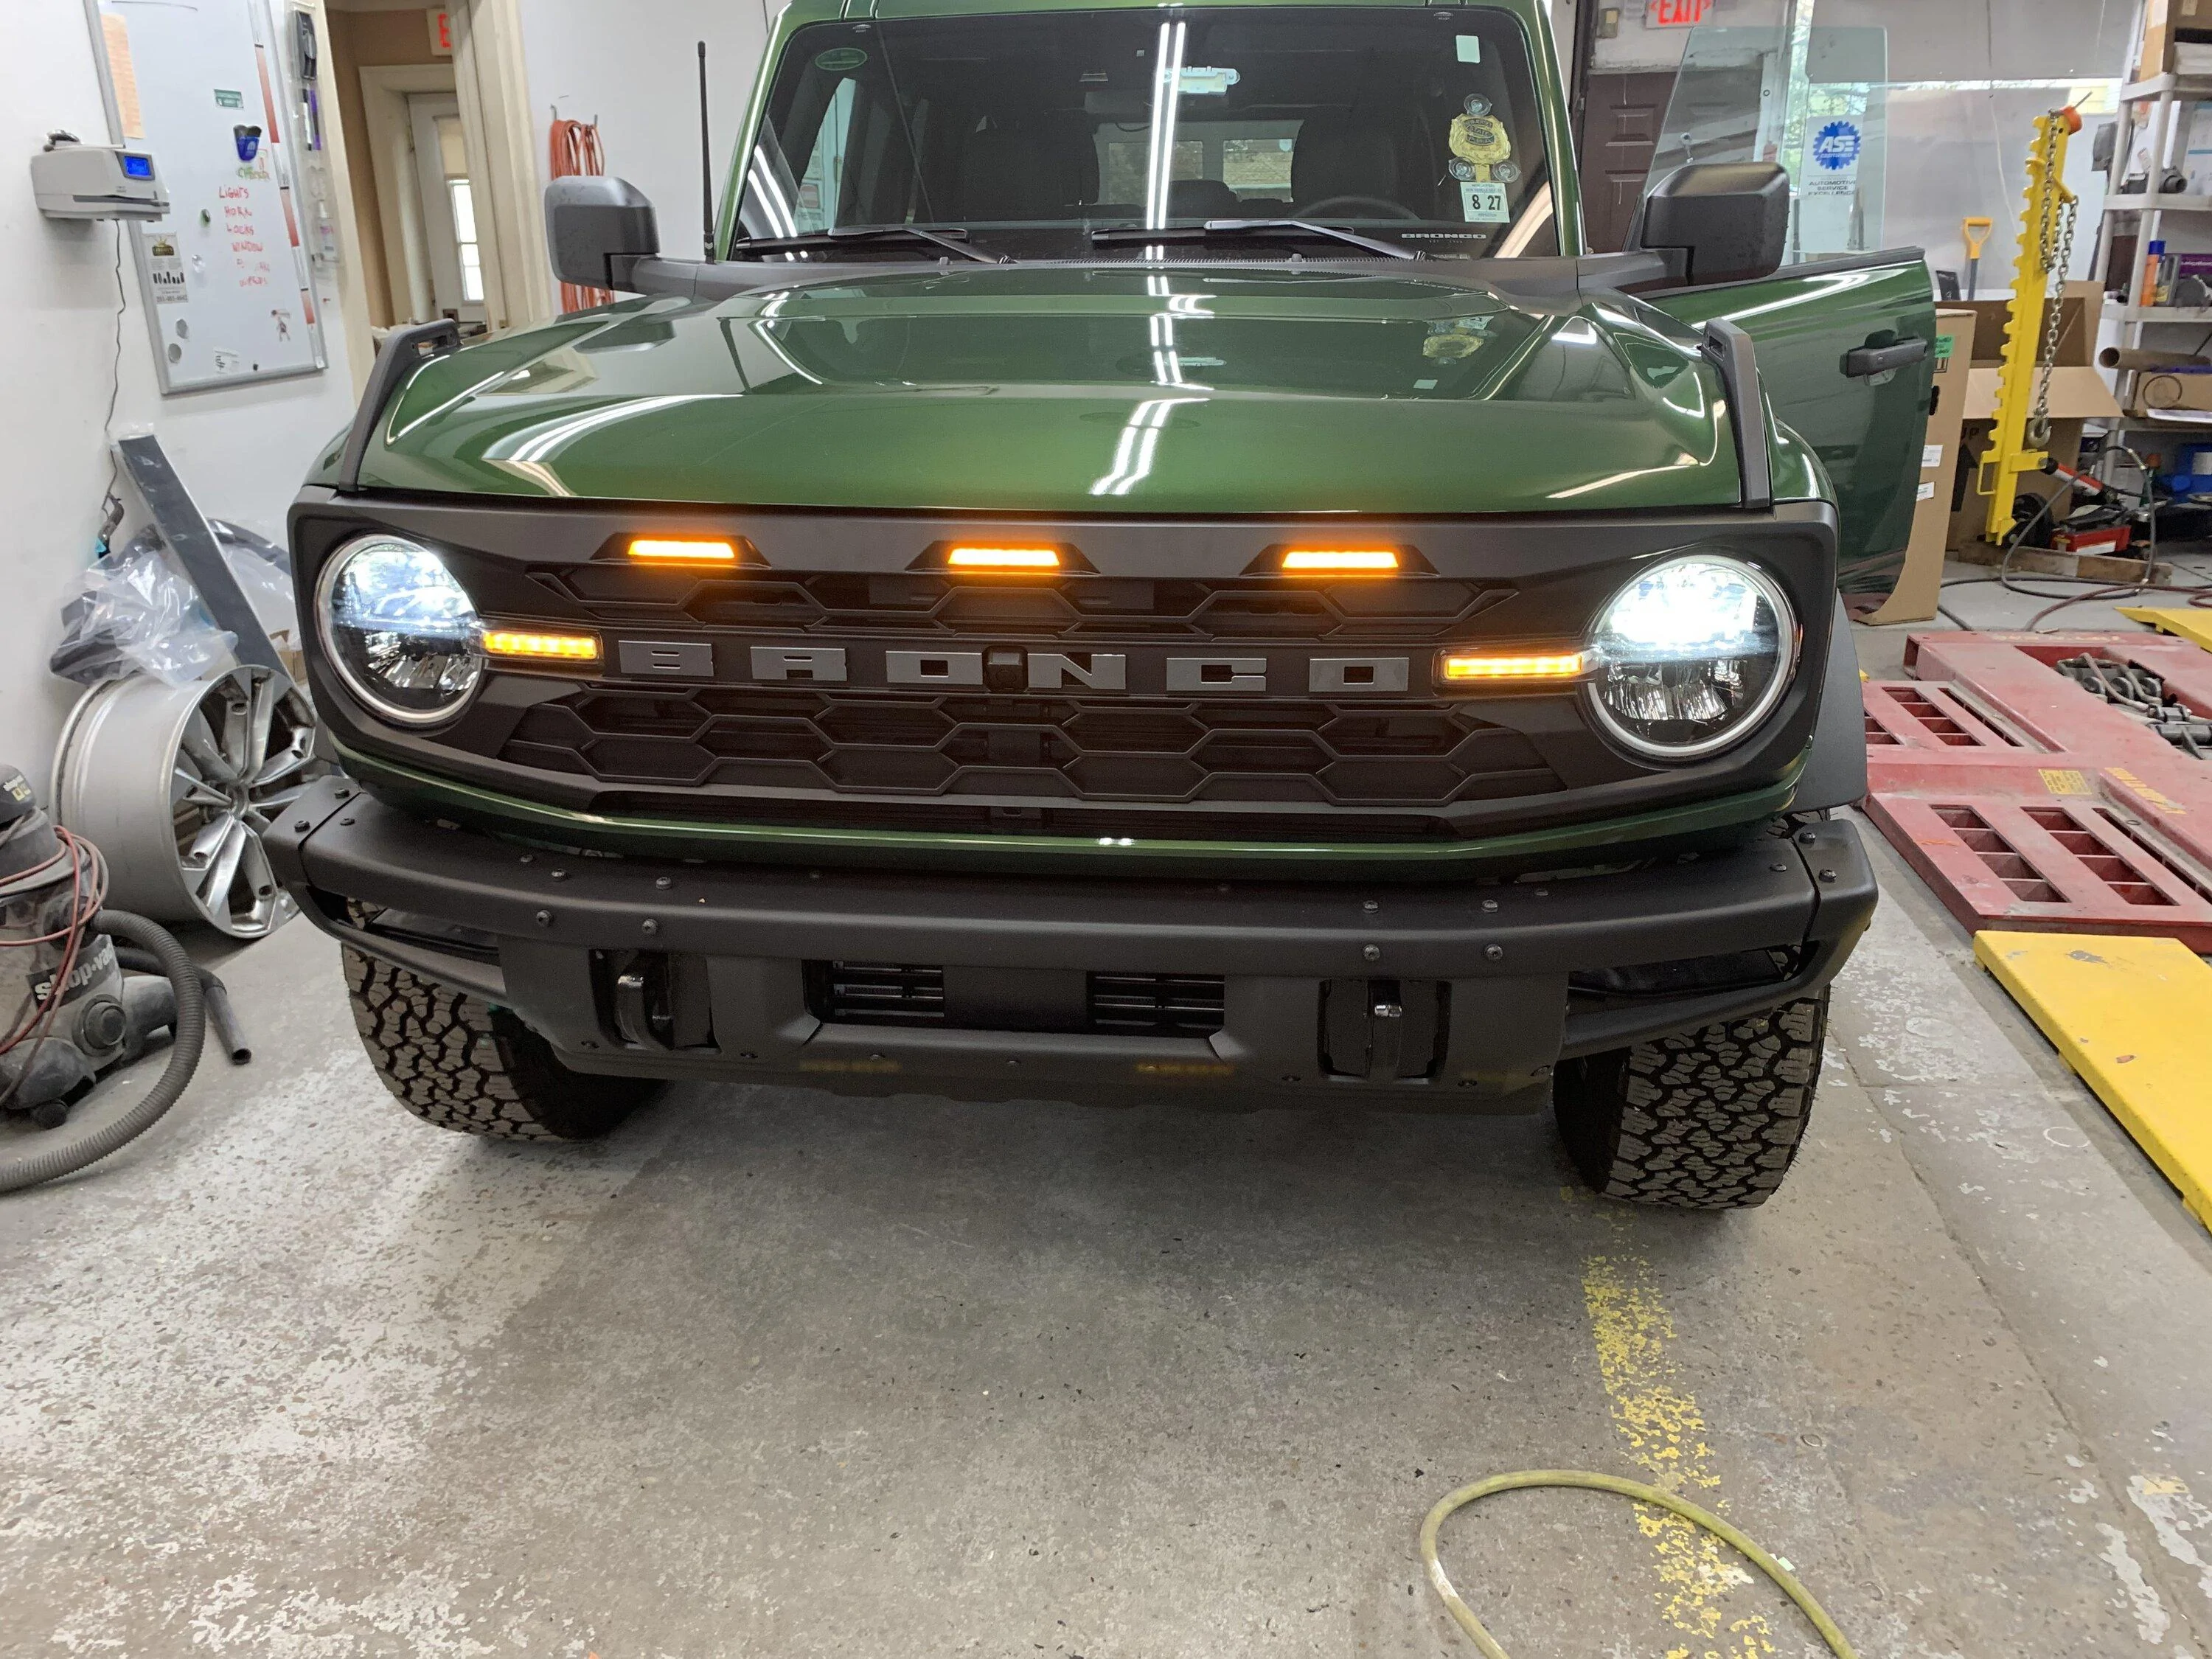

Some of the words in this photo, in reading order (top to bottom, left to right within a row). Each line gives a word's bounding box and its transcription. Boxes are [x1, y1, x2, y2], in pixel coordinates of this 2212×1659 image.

[1658, 0, 1701, 24] EXIT
[1818, 136, 1856, 153] ASE
[1472, 194, 1481, 210] 8
[1486, 195, 1502, 211] 27
[618, 639, 1410, 692] BRONCO
